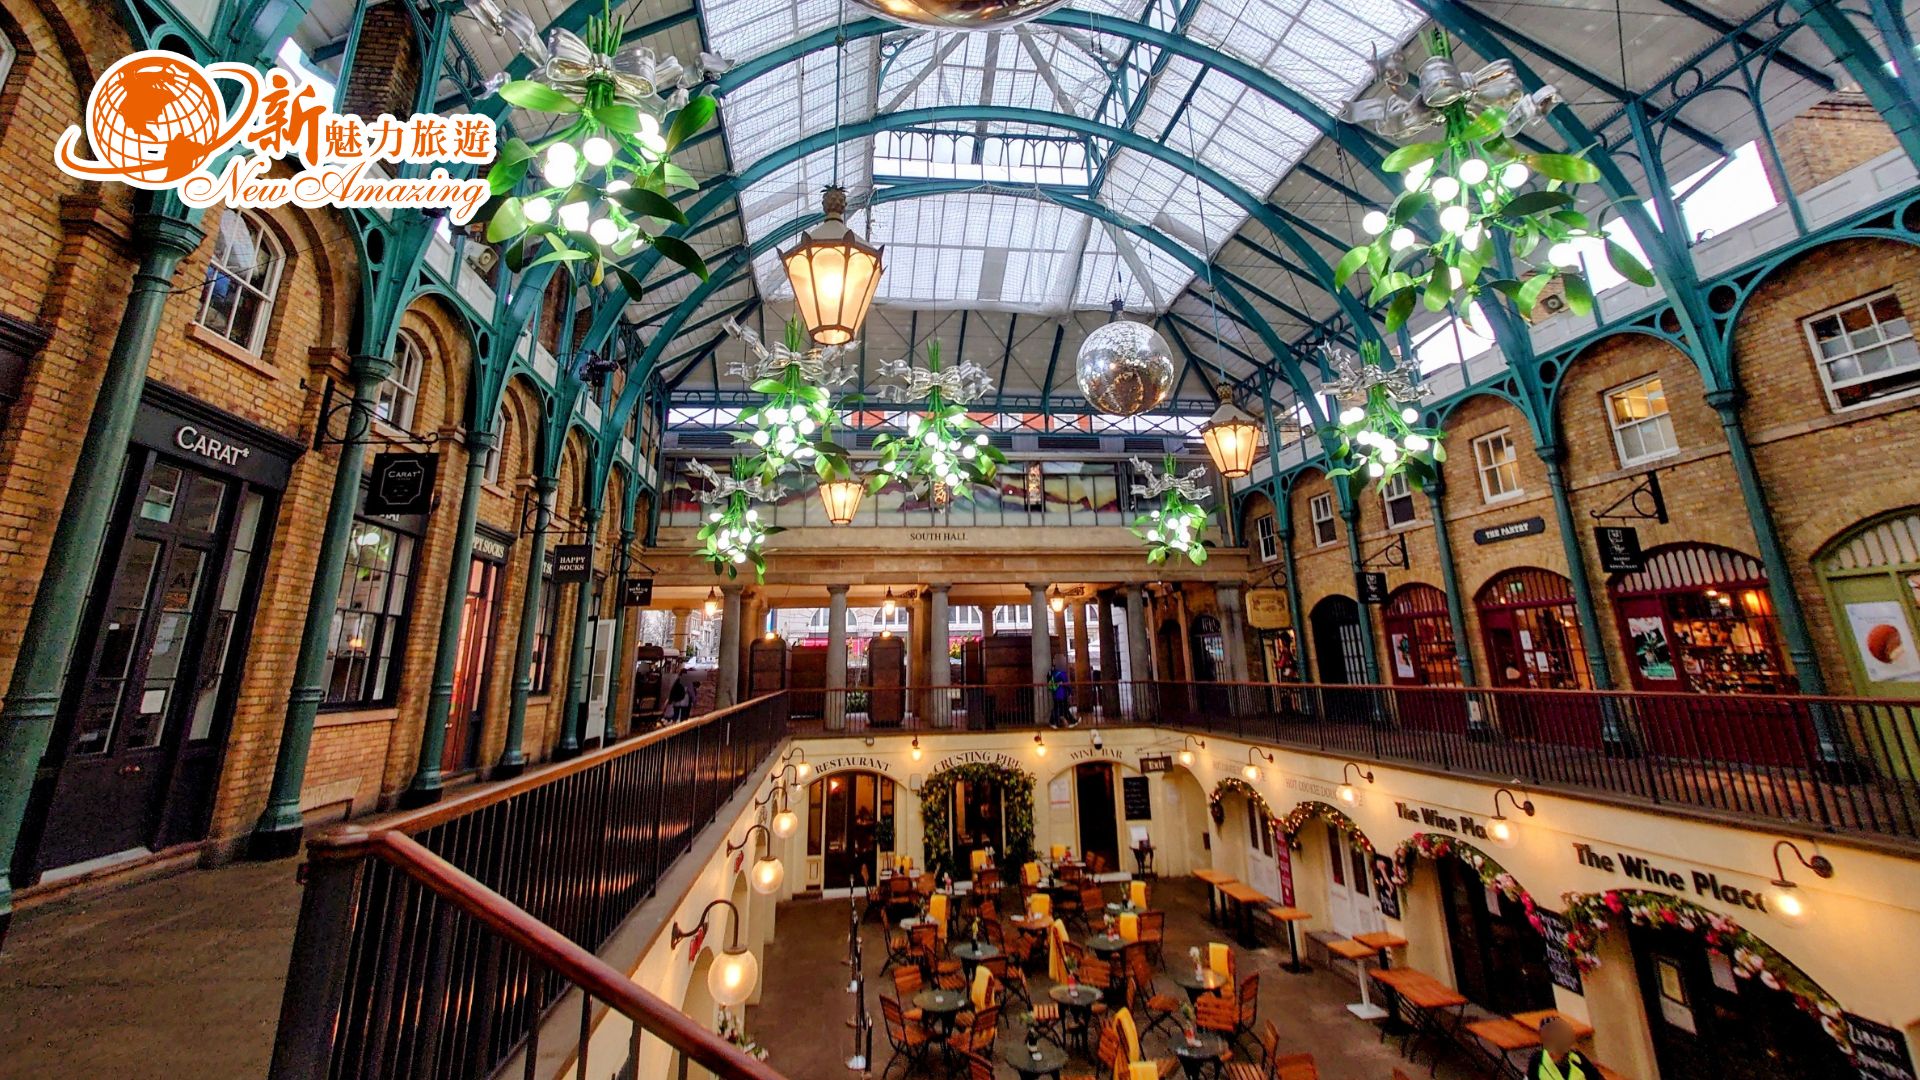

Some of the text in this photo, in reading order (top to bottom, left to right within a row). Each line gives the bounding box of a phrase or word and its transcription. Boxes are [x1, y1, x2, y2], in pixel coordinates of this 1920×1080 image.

[910, 532, 968, 541] SOUTH HALL
[1485, 522, 1529, 539] THE PANTRY
[482, 539, 505, 559] SOCKS
[559, 563, 585, 571] SOCKS
[560, 556, 586, 564] HAPPY
[933, 751, 991, 773] CRUSTING
[1069, 748, 1122, 760] WINE BAR
[815, 756, 892, 774] RESTAURANT
[1148, 760, 1165, 771] Exit
[1394, 801, 1490, 840] The Wine Pla
[1572, 842, 1615, 873] The
[1617, 852, 1685, 891] Wine
